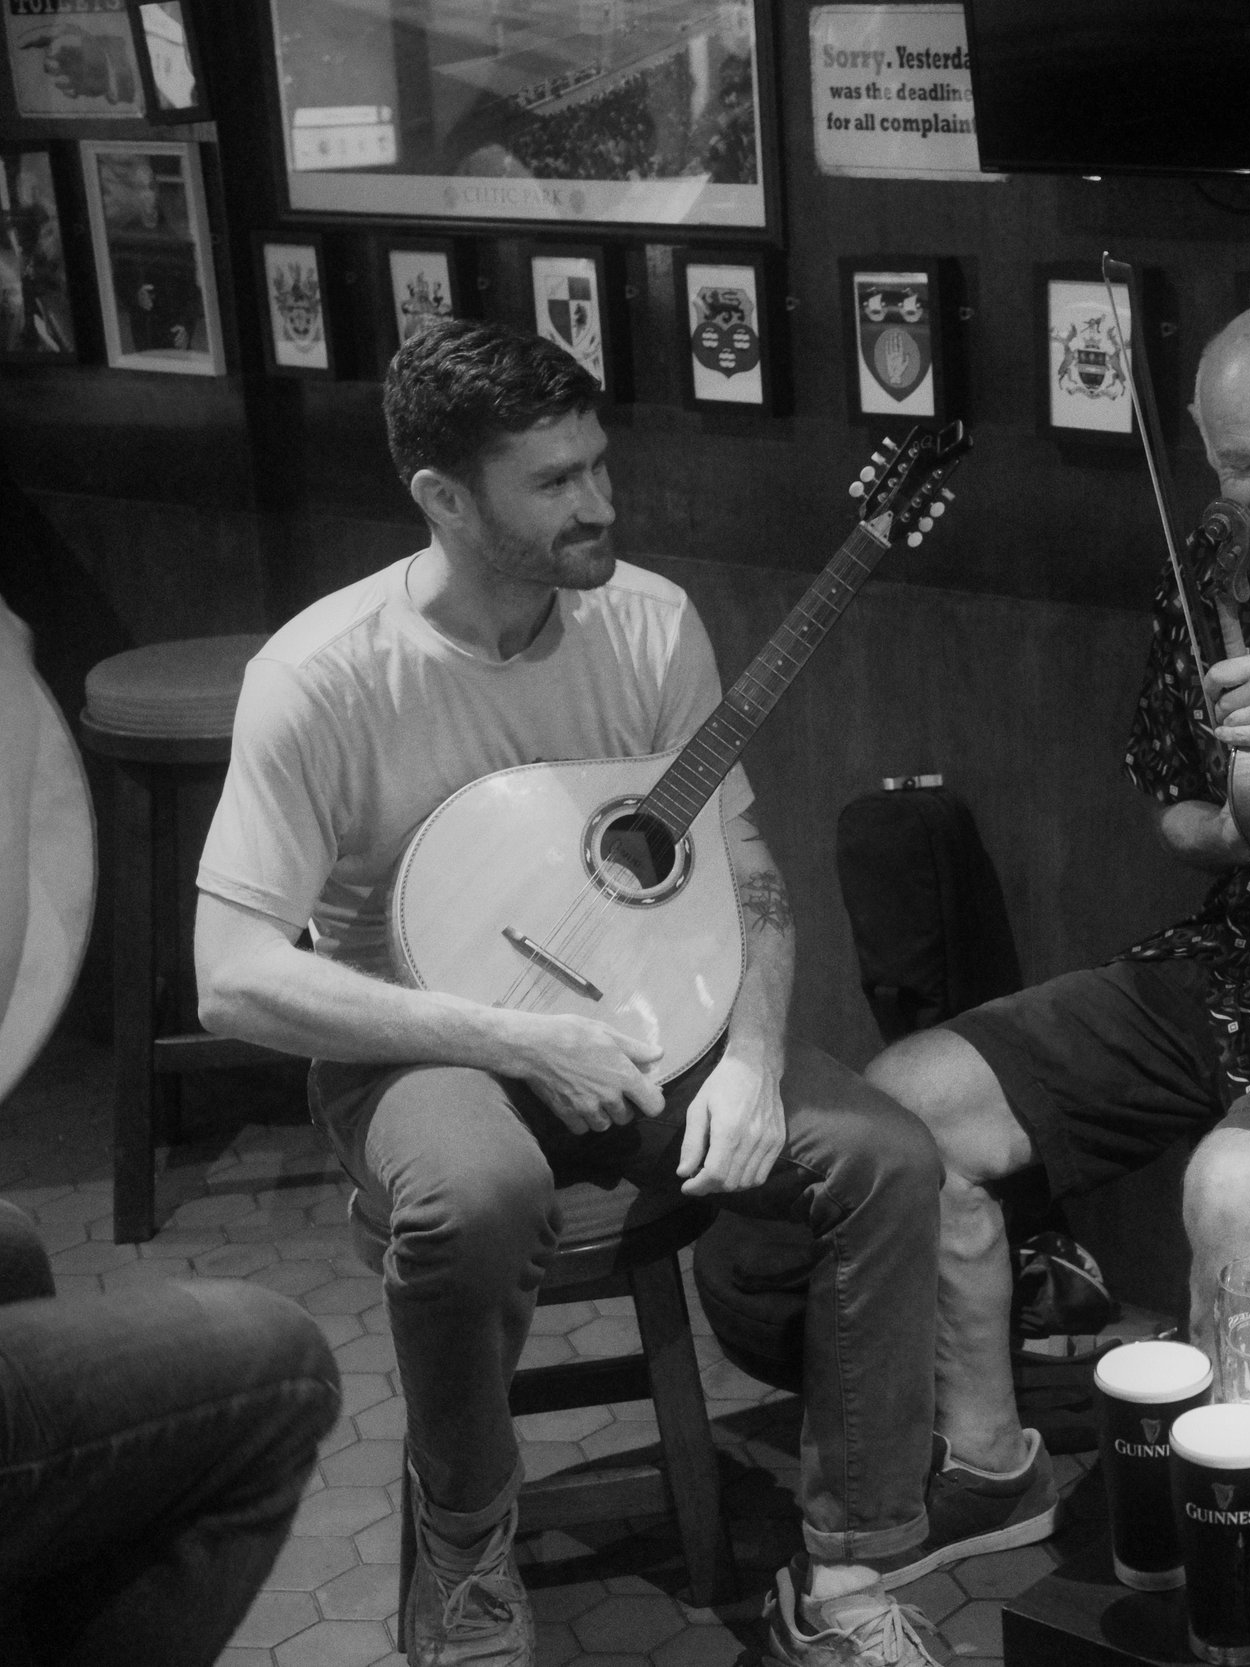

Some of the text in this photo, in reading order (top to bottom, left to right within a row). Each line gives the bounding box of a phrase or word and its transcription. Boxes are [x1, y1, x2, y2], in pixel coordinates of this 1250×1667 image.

[830, 82, 973, 102] was the deadline
[827, 112, 851, 130] for
[855, 113, 875, 131] all
